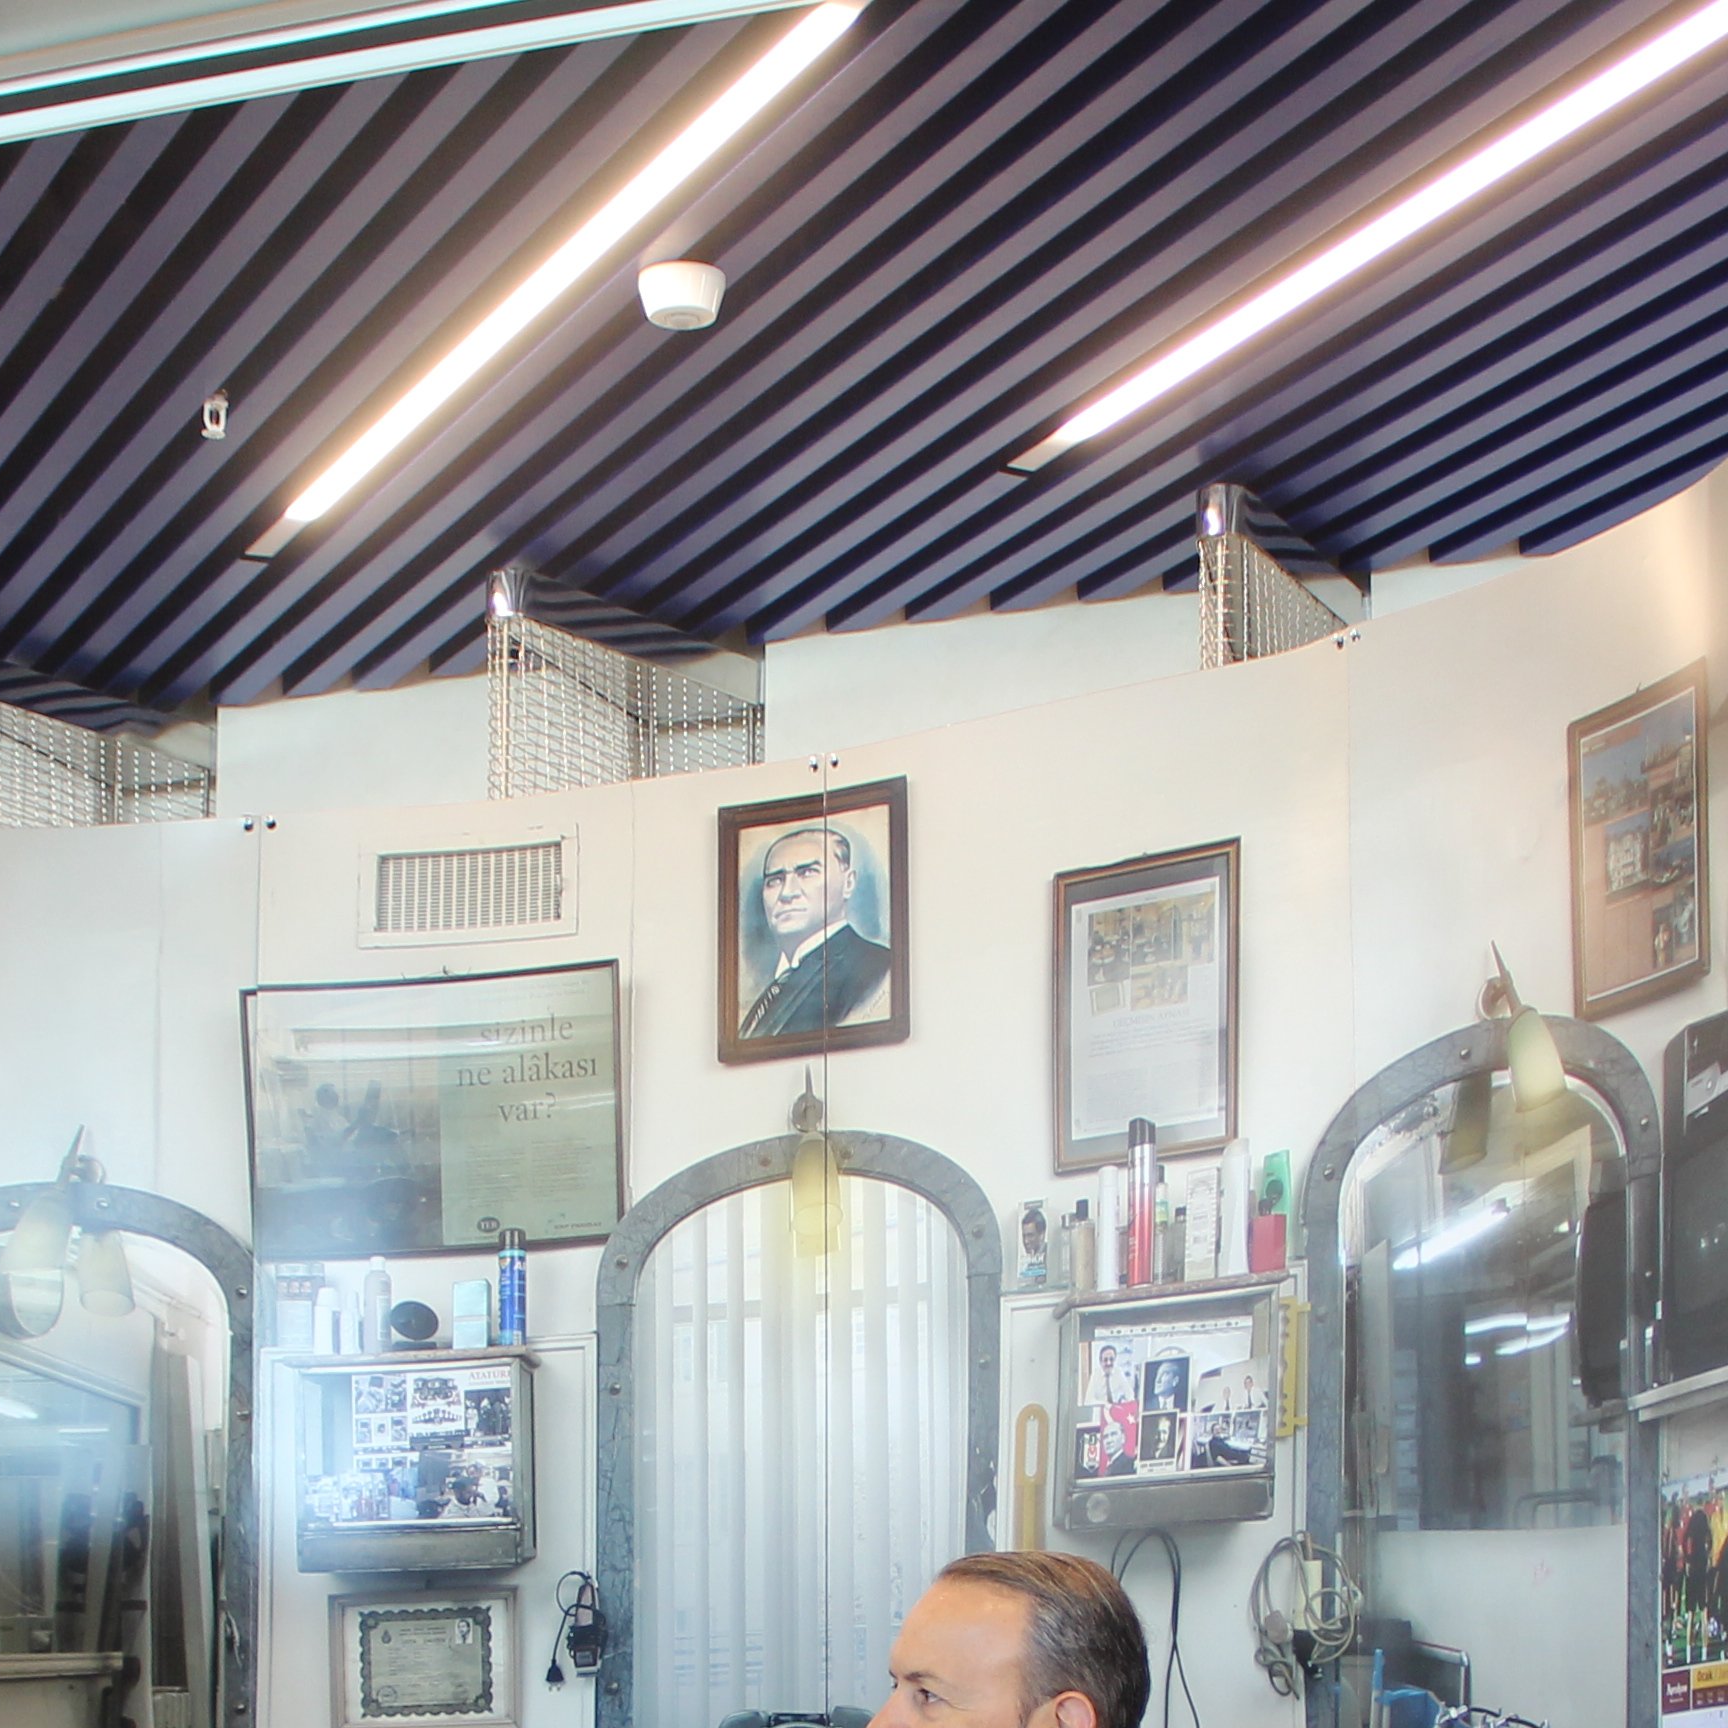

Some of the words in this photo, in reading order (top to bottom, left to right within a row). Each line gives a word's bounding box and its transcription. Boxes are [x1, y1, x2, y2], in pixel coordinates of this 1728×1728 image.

[480, 1011, 574, 1045] sizinle
[456, 1066, 492, 1088] ne
[502, 1051, 599, 1084] alâkası
[497, 1091, 558, 1123] var?
